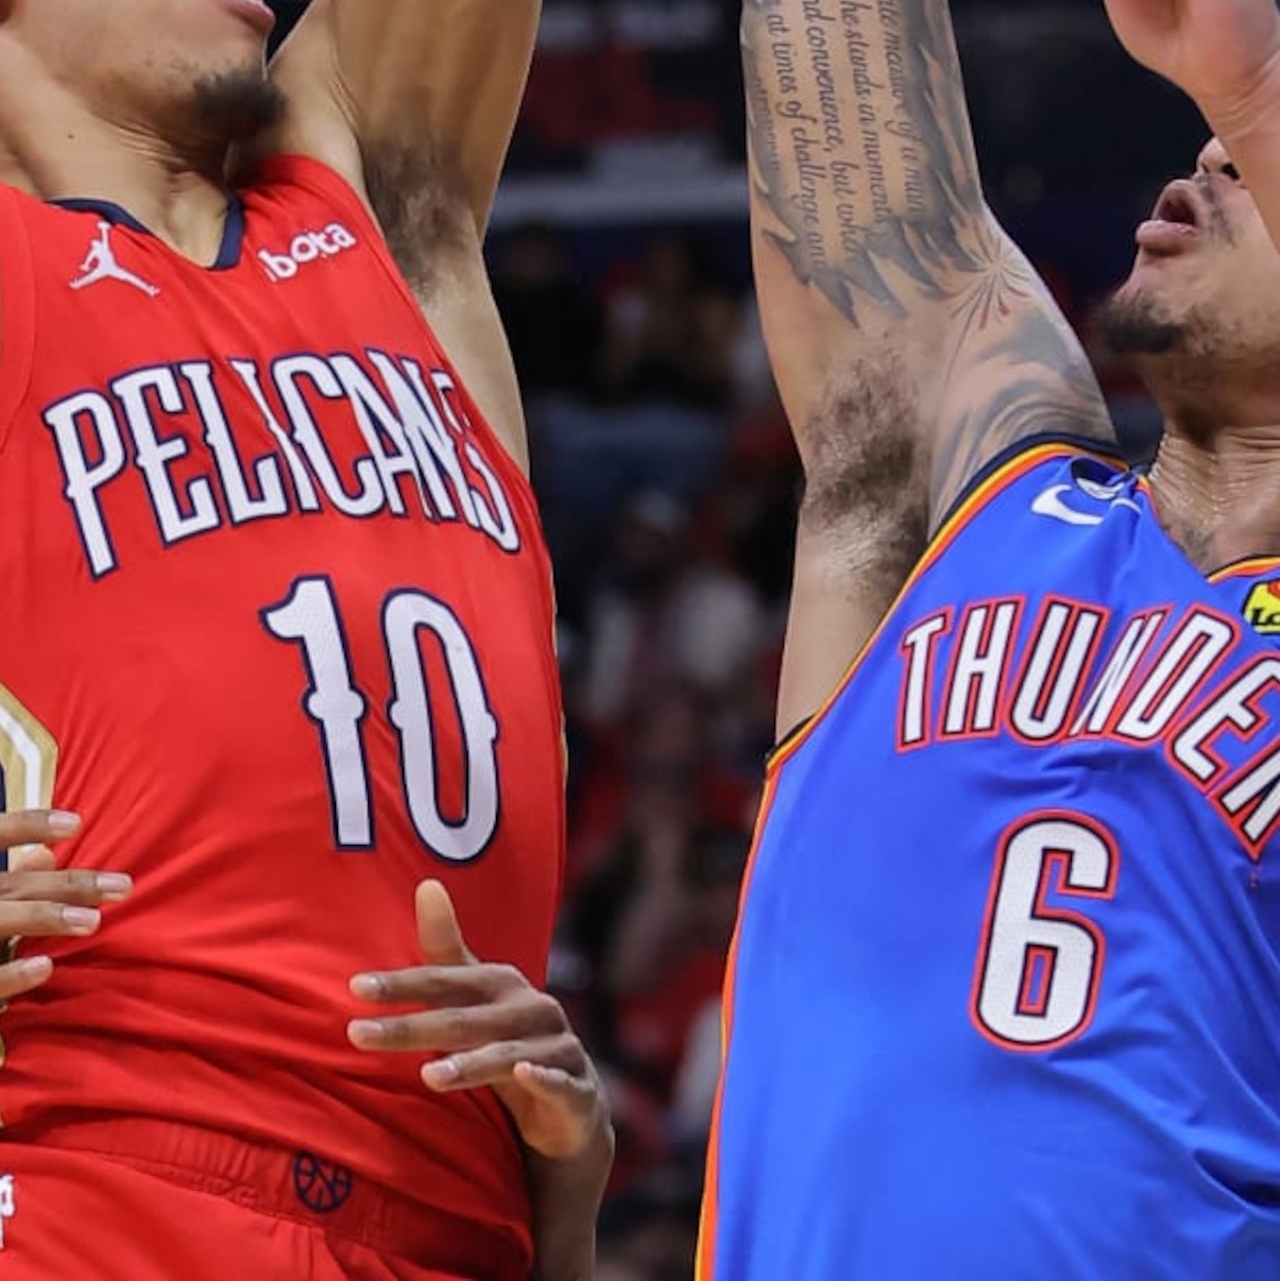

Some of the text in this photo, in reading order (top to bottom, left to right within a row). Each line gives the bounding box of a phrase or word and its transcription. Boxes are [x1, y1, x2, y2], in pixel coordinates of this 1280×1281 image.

[766, 15, 793, 36] at
[839, 0, 873, 30] he
[772, 42, 799, 93] times
[844, 30, 886, 97] stands
[774, 100, 819, 125] of
[857, 103, 877, 125] in
[884, 120, 923, 143] of
[789, 126, 828, 227] challenge
[830, 161, 861, 199] but
[861, 129, 893, 224] moments
[256, 221, 360, 283] bota
[42, 349, 522, 581] PELICANS
[259, 574, 501, 866] 10
[969, 809, 1122, 1053] 6
